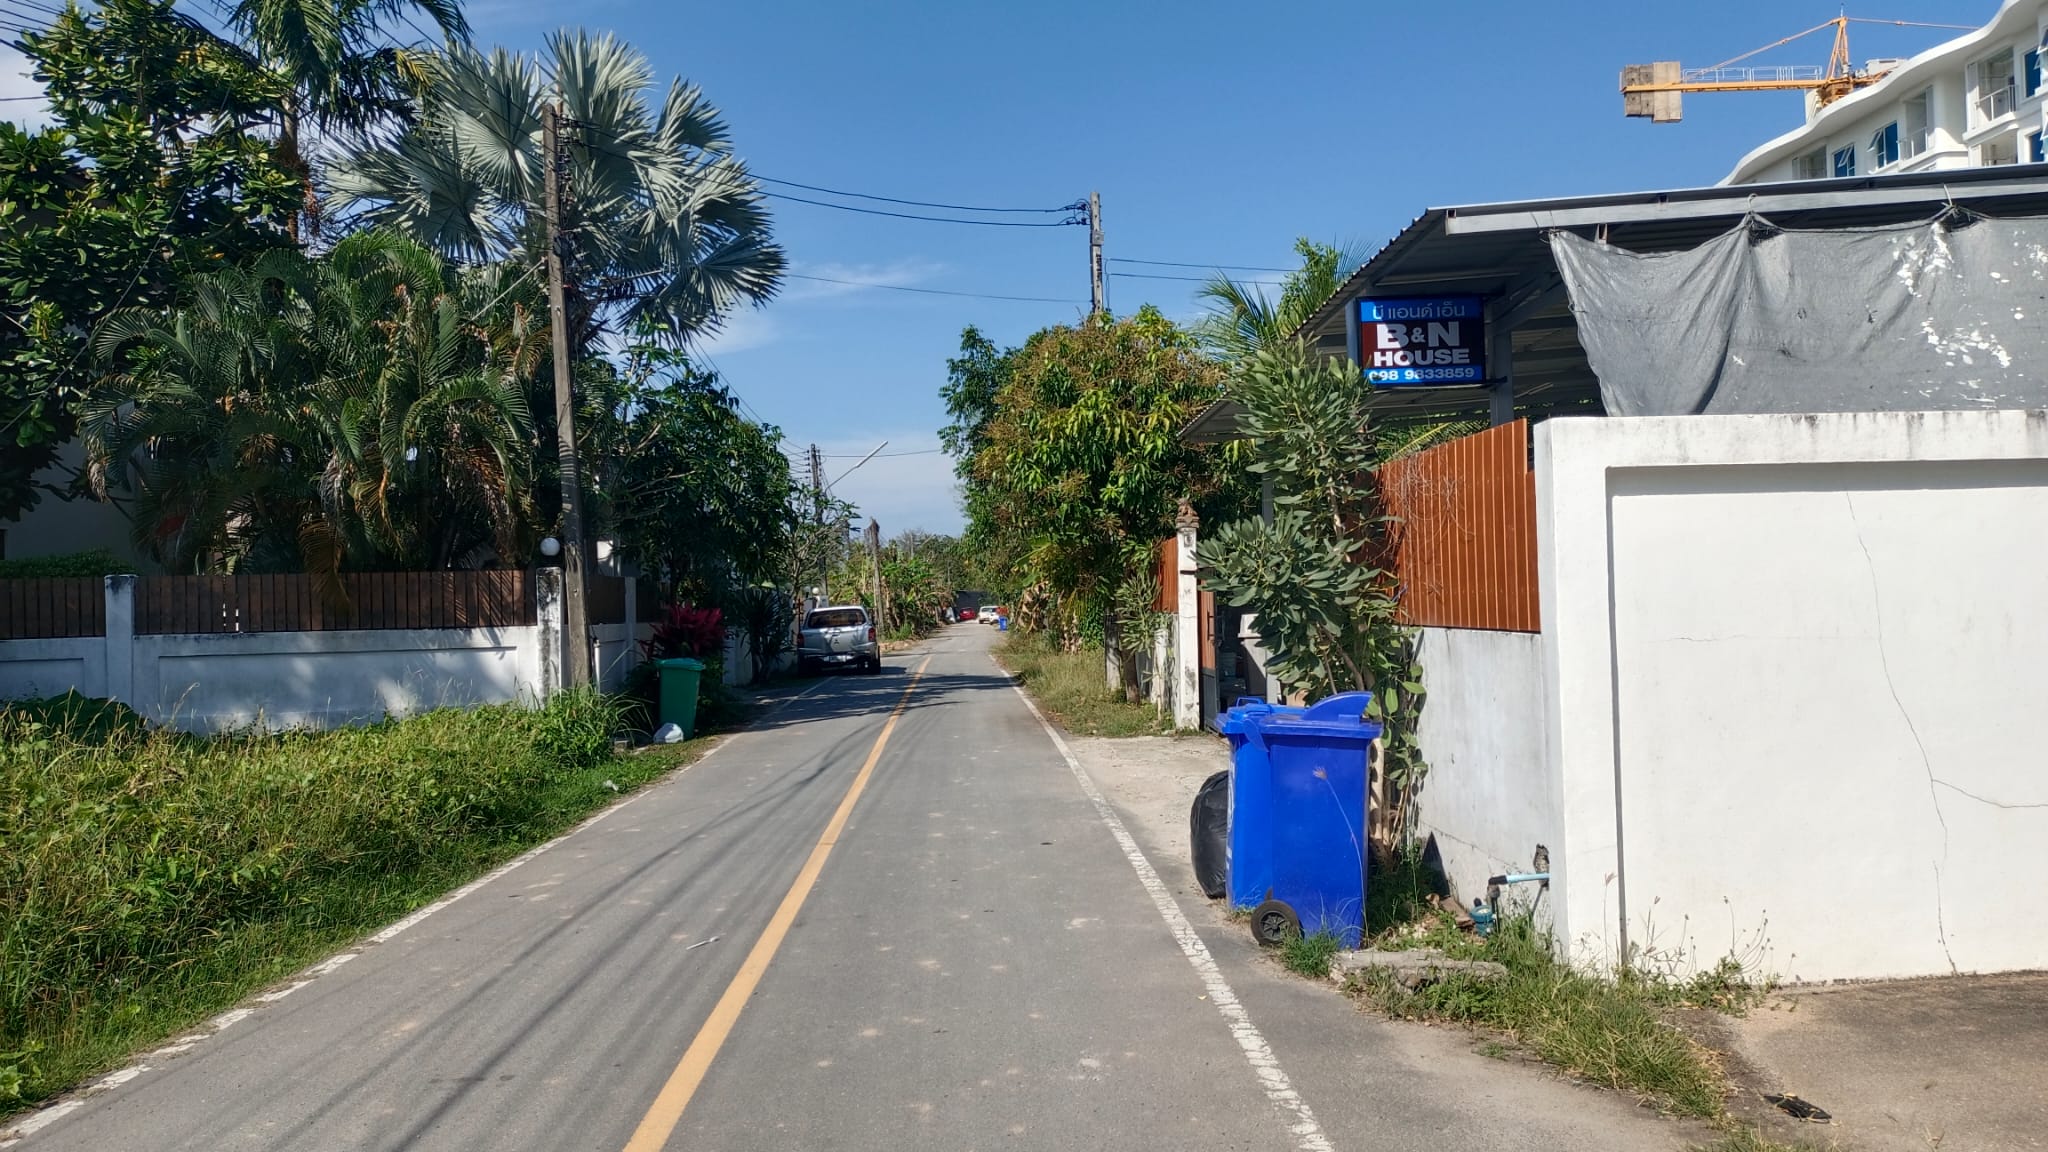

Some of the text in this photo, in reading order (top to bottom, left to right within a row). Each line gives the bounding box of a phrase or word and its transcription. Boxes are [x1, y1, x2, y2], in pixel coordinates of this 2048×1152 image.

[1388, 302, 1433, 319] แอนด์
[1436, 300, 1465, 318] เอ็น
[1376, 321, 1460, 350] B&N
[1373, 348, 1470, 367] HOUSE
[1368, 367, 1475, 382] 098 9833859
